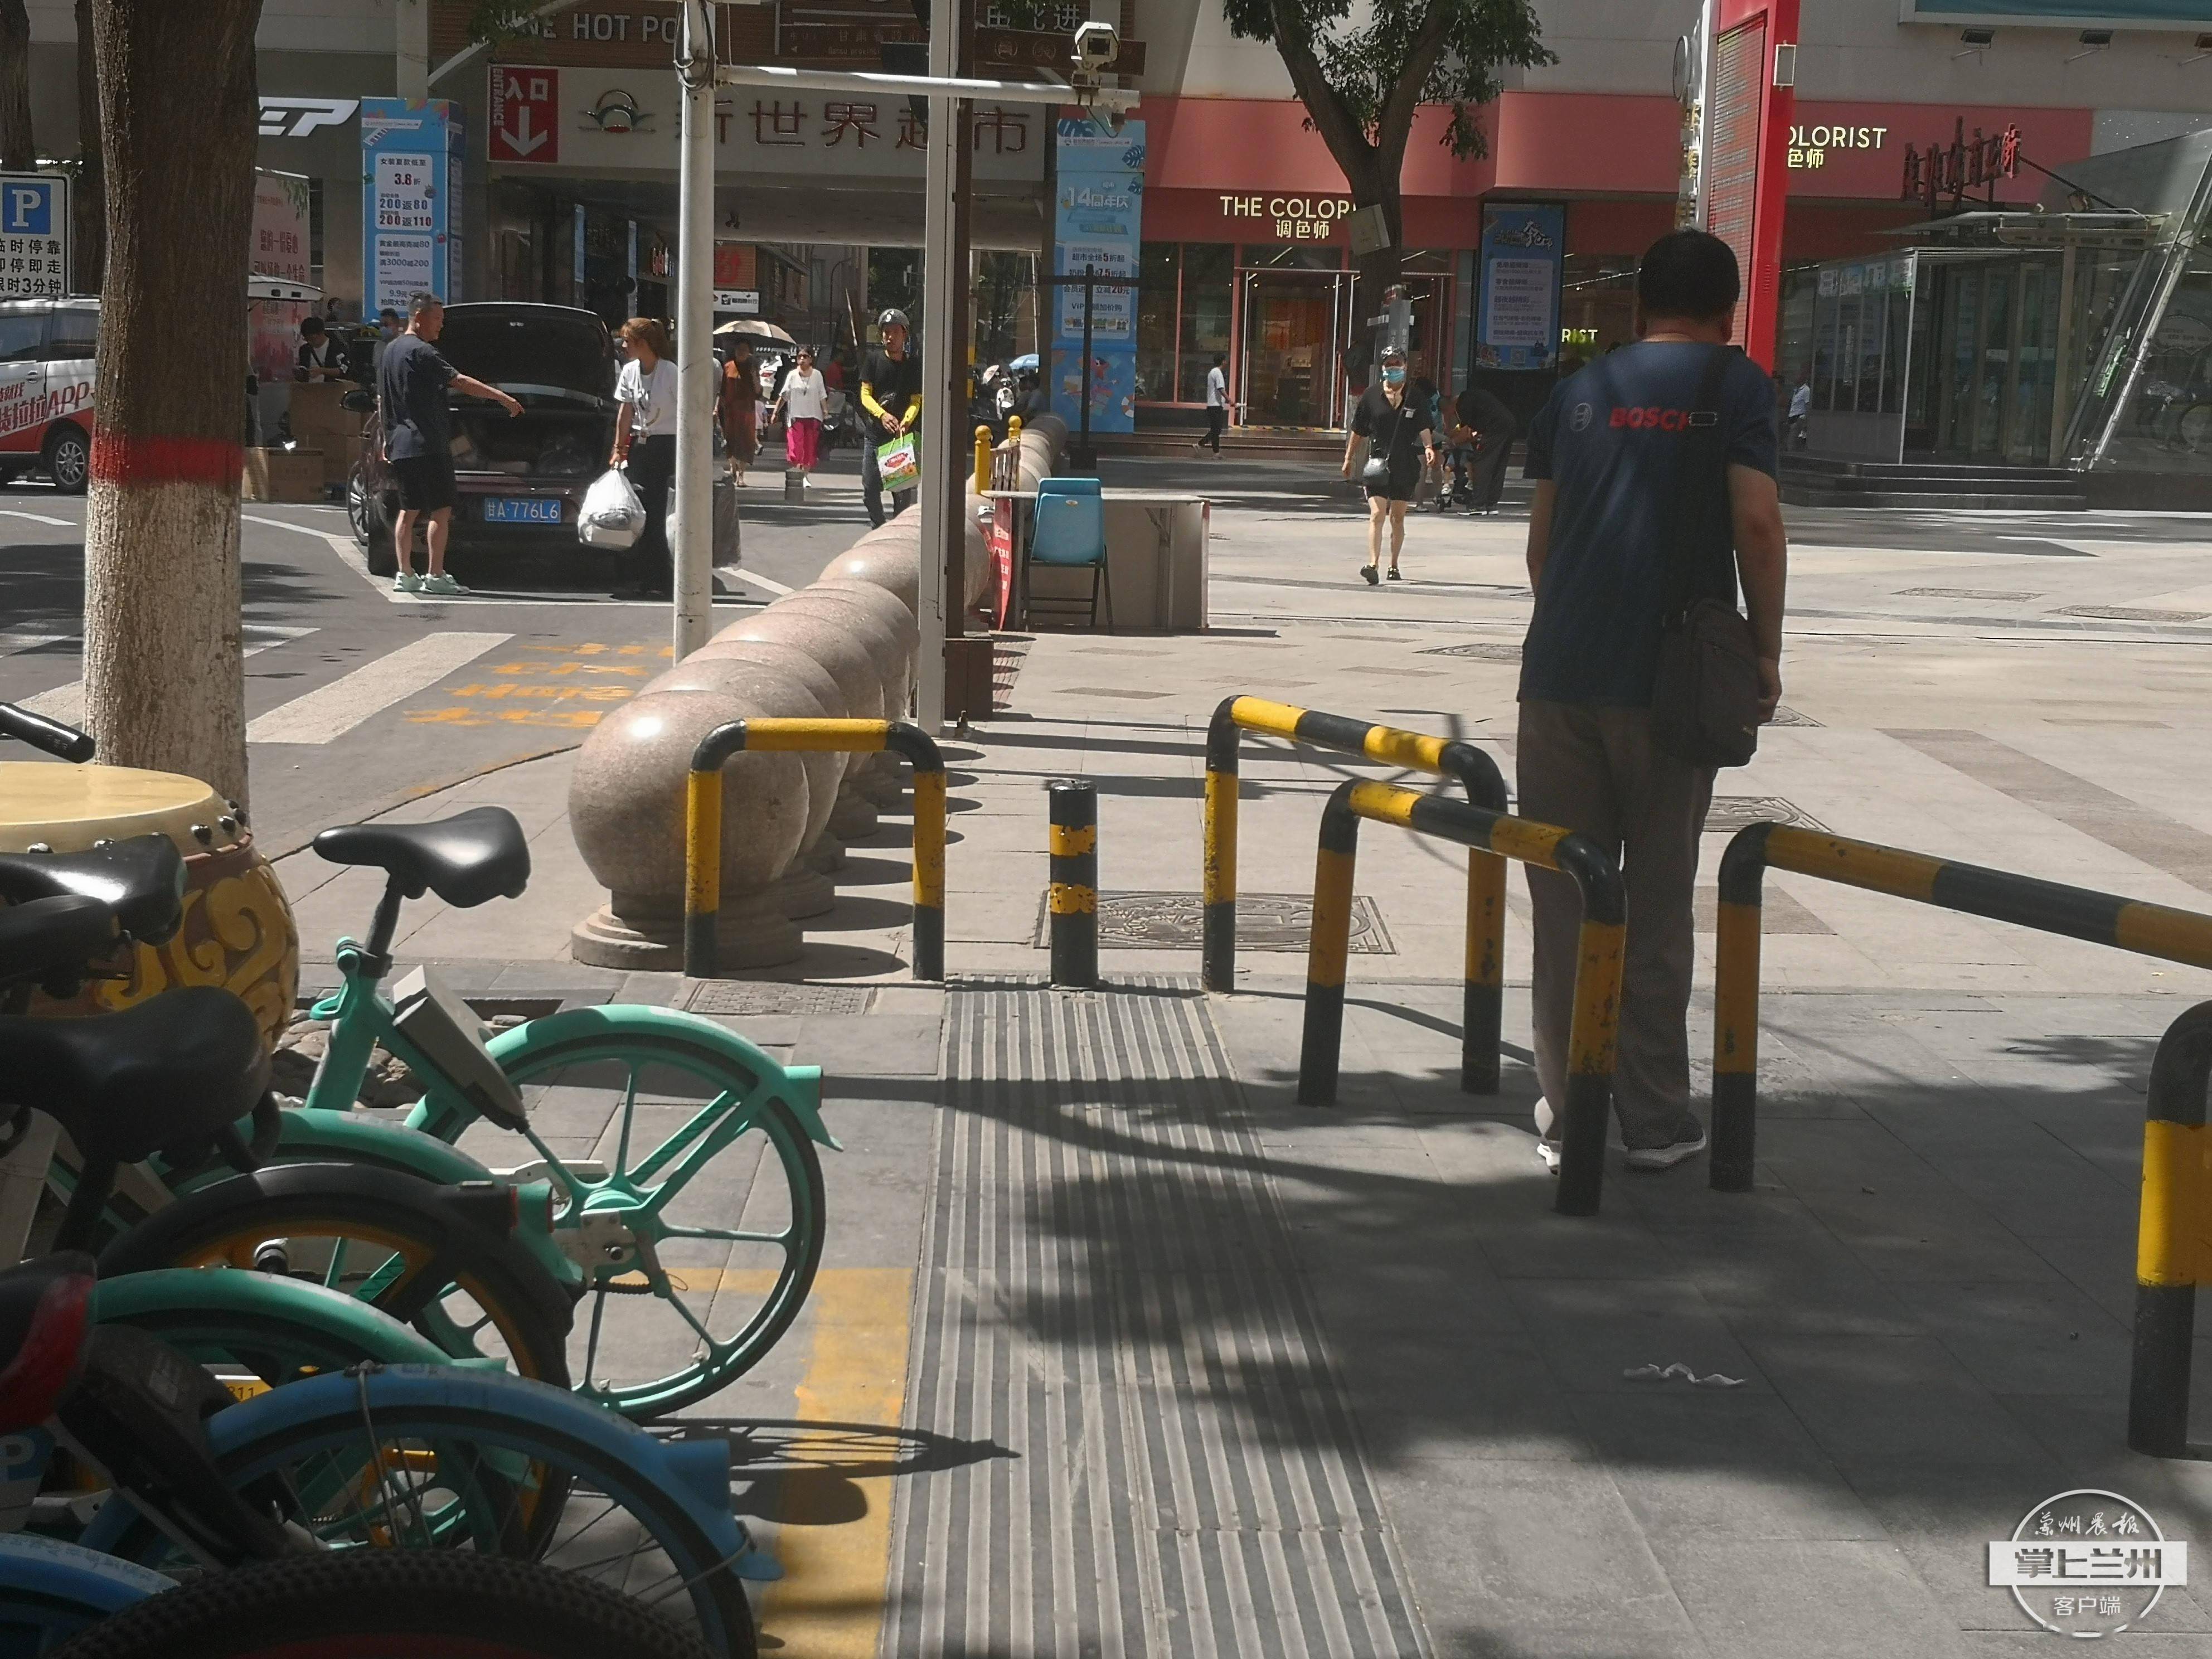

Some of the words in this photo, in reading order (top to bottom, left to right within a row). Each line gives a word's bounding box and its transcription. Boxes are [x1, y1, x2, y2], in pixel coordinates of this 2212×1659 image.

[573, 13, 630, 41] HOT
[493, 68, 505, 127] ENTRANCE
[504, 76, 549, 102] 入口
[12, 189, 42, 227] P
[380, 198, 428, 210] 200返80
[1220, 196, 1263, 216] THE
[379, 215, 431, 226] 200返110
[1276, 219, 1330, 239] 调色师
[1064, 285, 1130, 294] 会员进立减20元
